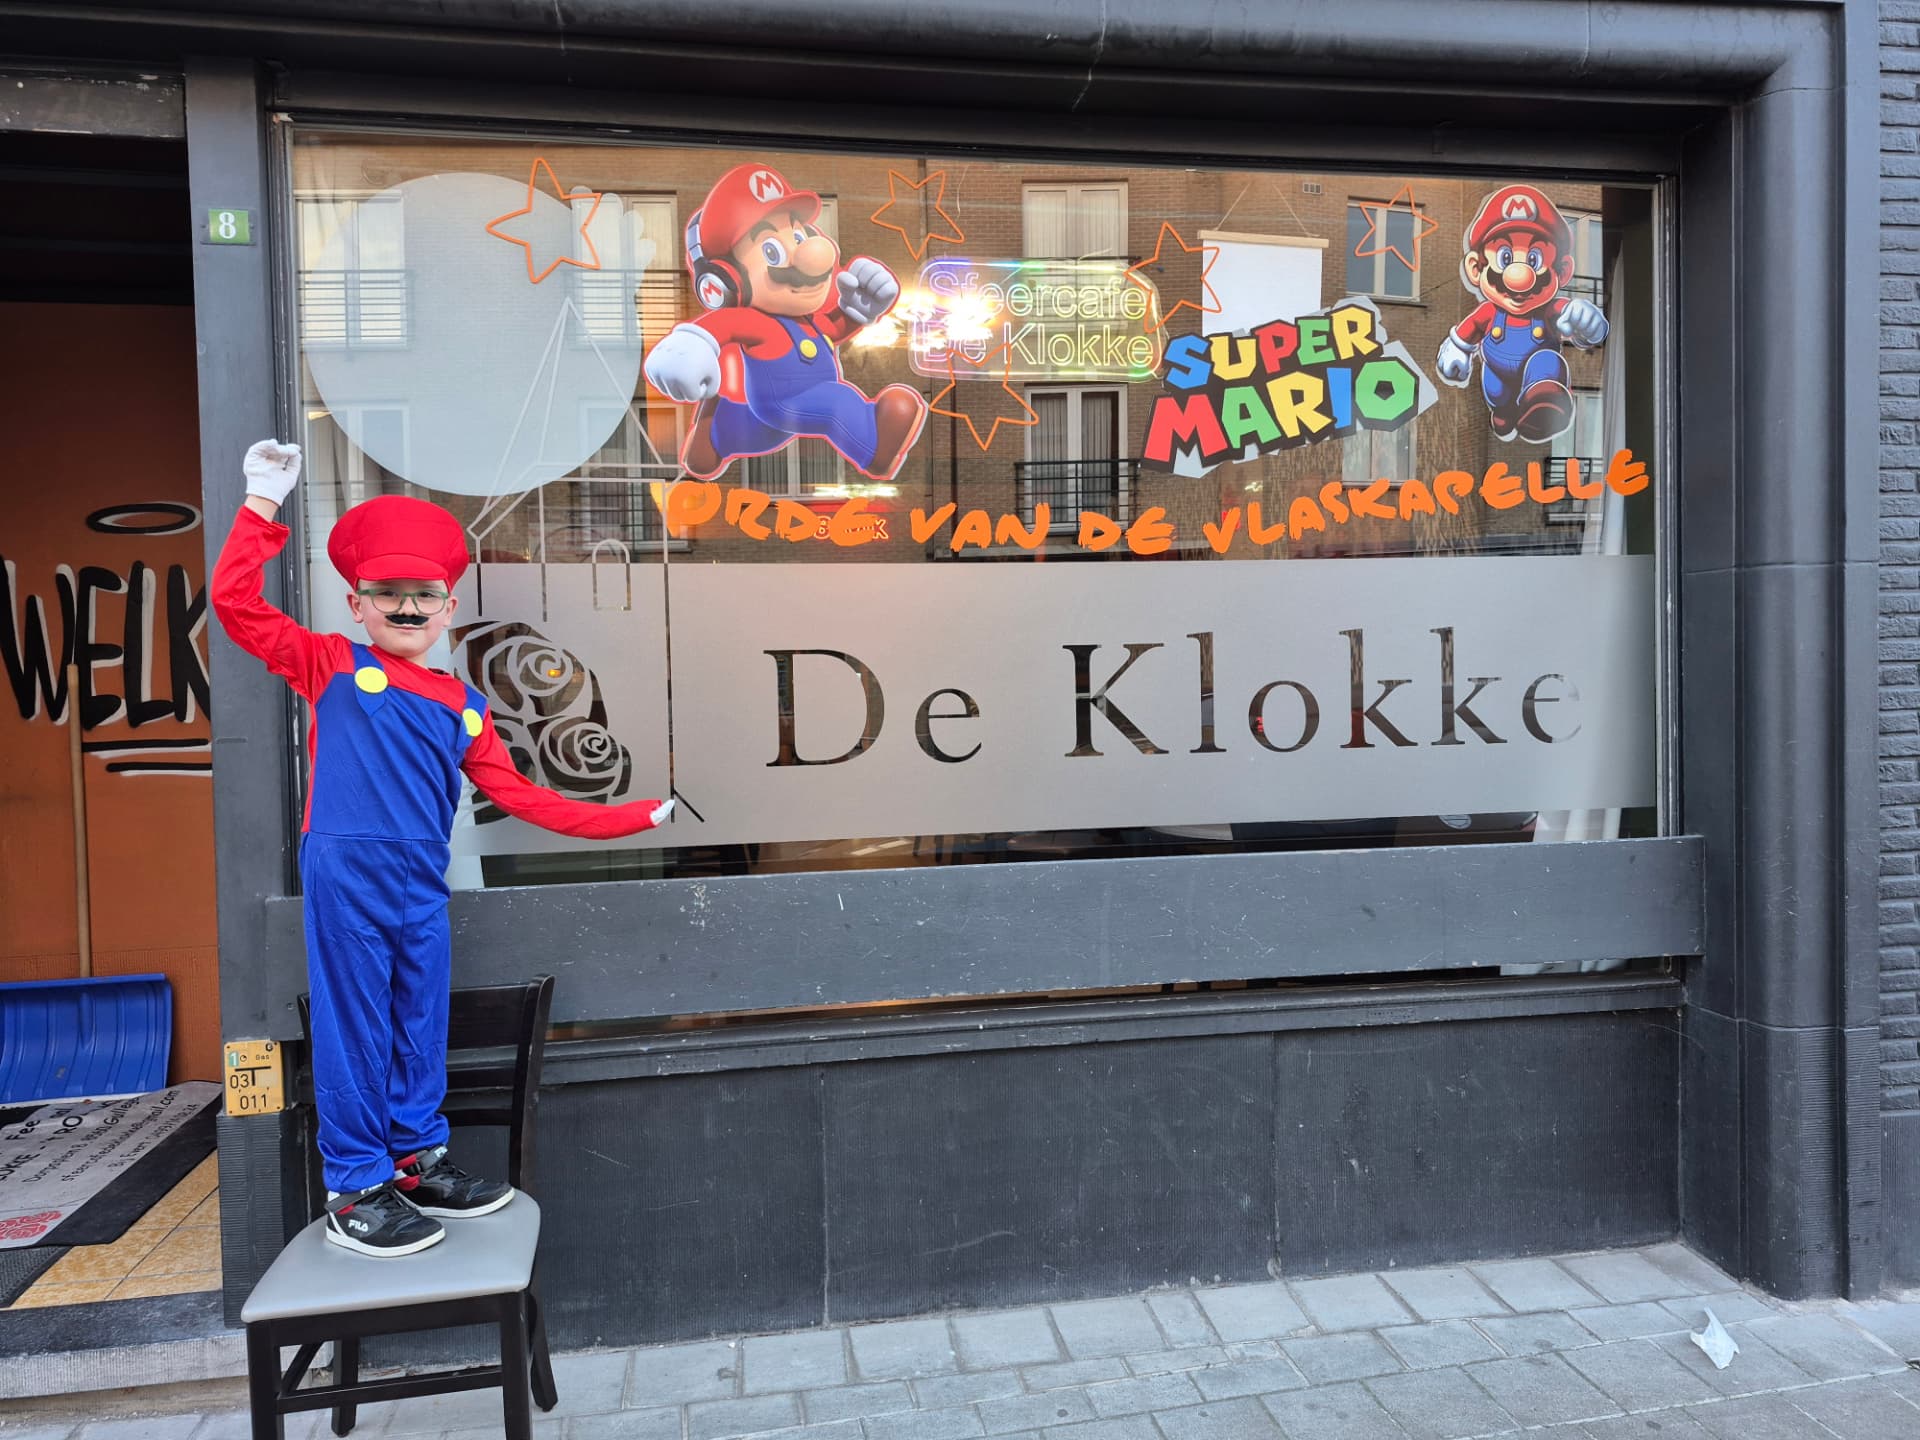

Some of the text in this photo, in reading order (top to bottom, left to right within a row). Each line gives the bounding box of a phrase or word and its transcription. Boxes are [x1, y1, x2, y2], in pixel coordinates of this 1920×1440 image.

[218, 211, 237, 240] 8
[928, 271, 1148, 320] Sfeercafe
[1003, 321, 1155, 368] Klokke
[1163, 305, 1380, 391] SUPER
[1142, 359, 1418, 464] MARIO
[909, 501, 1051, 553] VAN
[1078, 505, 1176, 556] DE
[1202, 448, 1650, 554] VLASKAPELLE
[763, 626, 1582, 767] De Klokke
[230, 1073, 250, 1090] 03
[240, 1093, 268, 1111] 011
[348, 1218, 370, 1233] FILA
